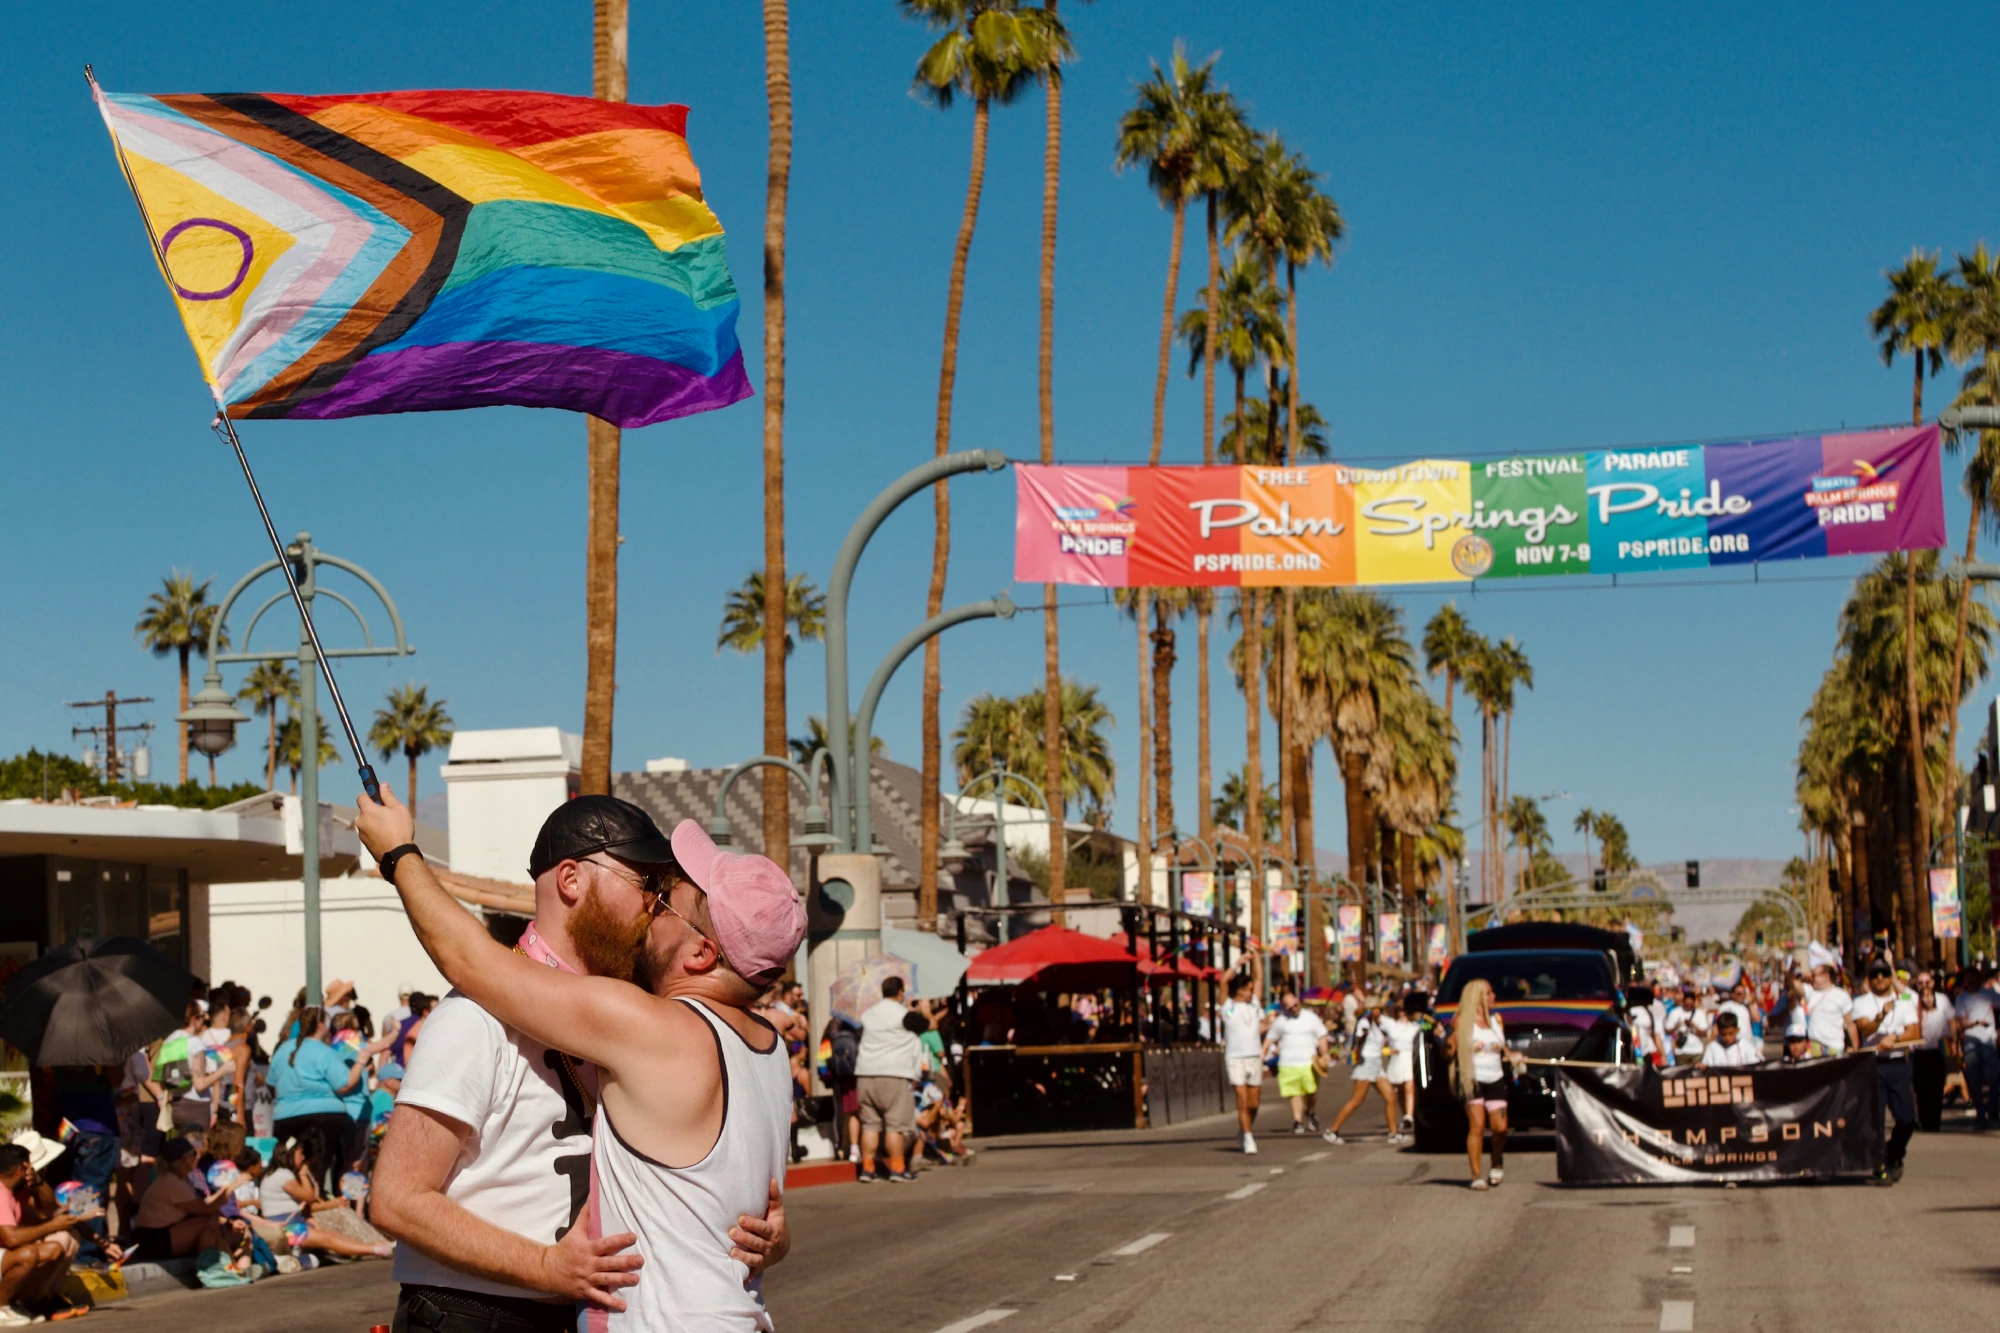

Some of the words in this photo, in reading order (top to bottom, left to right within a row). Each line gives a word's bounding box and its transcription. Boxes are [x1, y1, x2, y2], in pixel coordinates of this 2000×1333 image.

[1258, 470, 1310, 486] FREE
[1336, 465, 1460, 485] DOWNTOWN
[1486, 458, 1584, 479] FESTIVAL
[1604, 449, 1690, 472] PARADE
[1813, 477, 1857, 489] GREATER
[1806, 491, 1841, 506] PALM
[1843, 484, 1897, 502] SPRINGS
[1188, 498, 1345, 539] Palm
[1361, 494, 1578, 549] Springs
[1587, 479, 1752, 525] Pride
[1817, 502, 1886, 526] PRIDE
[1061, 534, 1125, 556] PRIDE
[1515, 545, 1555, 565] NOV
[1558, 543, 1591, 563] 7-9
[1618, 533, 1750, 560] PSPRIDE.ORG
[1193, 553, 1321, 572] PSPRIDE.ORG
[1704, 1150, 1778, 1165] SPRINGS
